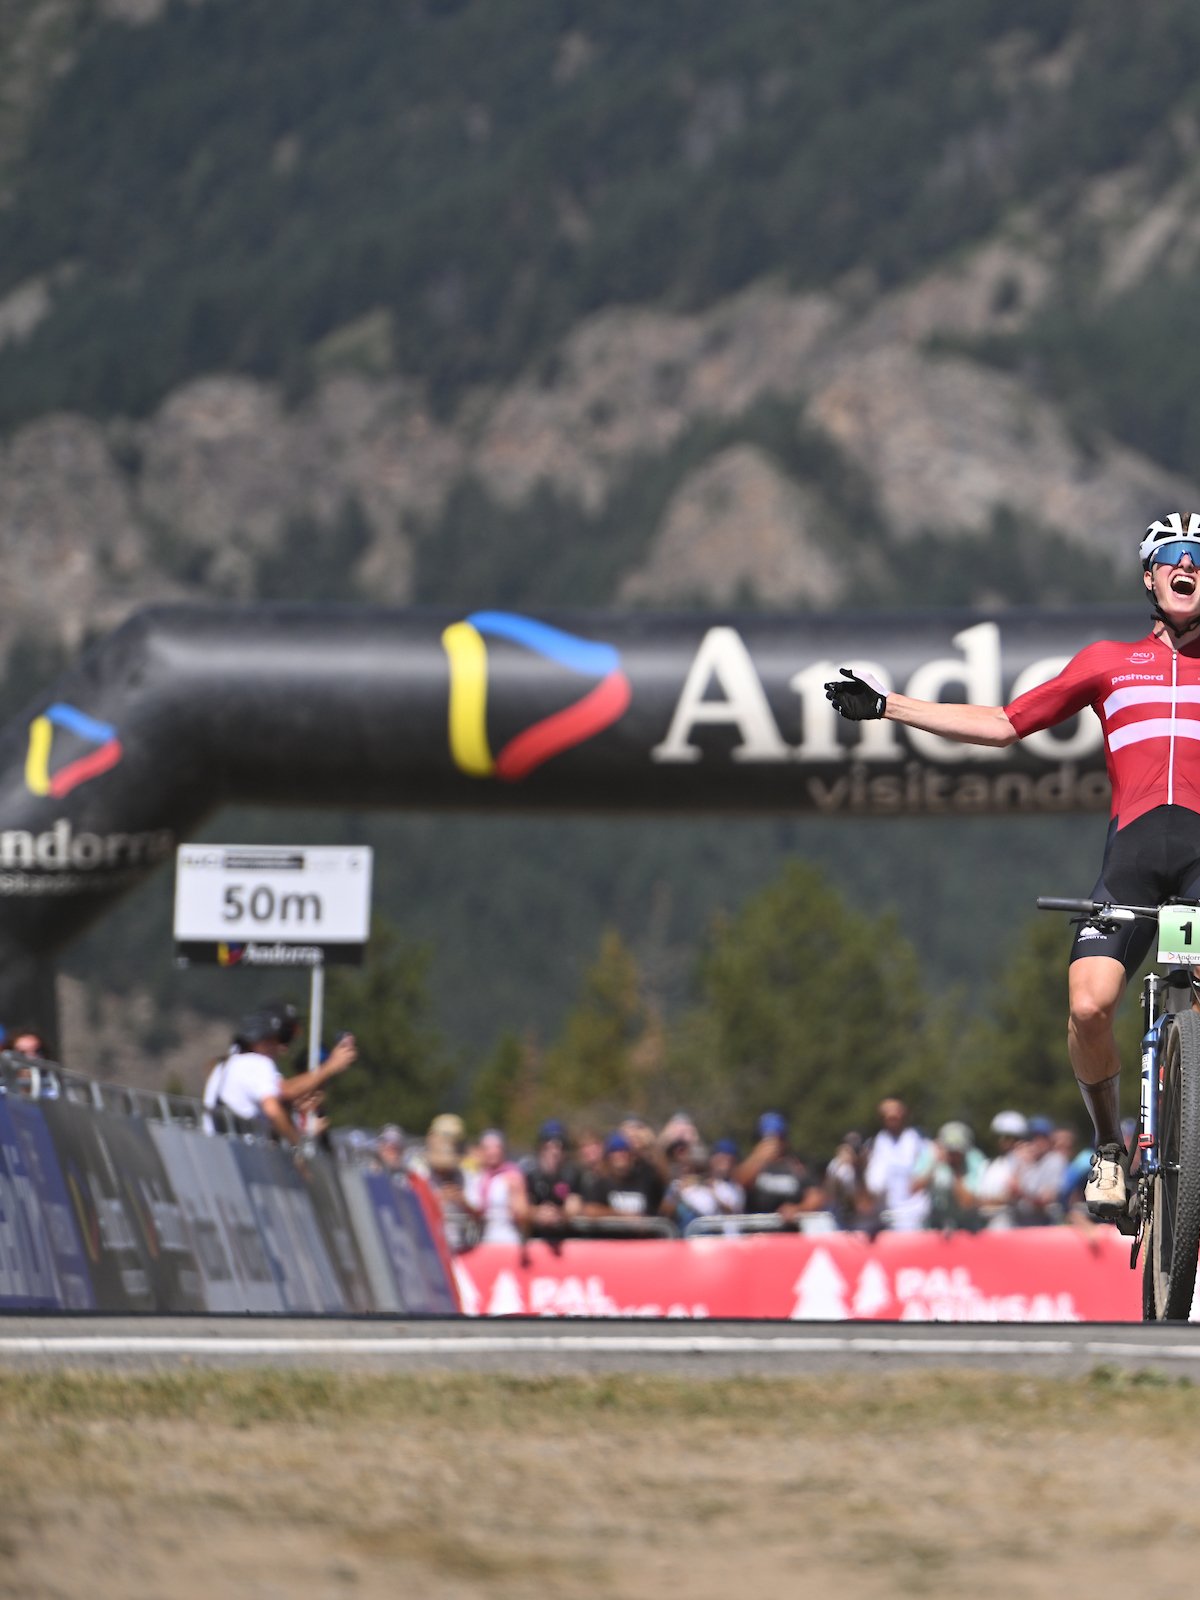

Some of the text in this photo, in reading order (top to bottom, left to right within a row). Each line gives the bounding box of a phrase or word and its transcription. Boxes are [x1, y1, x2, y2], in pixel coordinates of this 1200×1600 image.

[1111, 673, 1164, 685] postnord
[222, 885, 322, 921] 50m
[1180, 921, 1193, 945] 1
